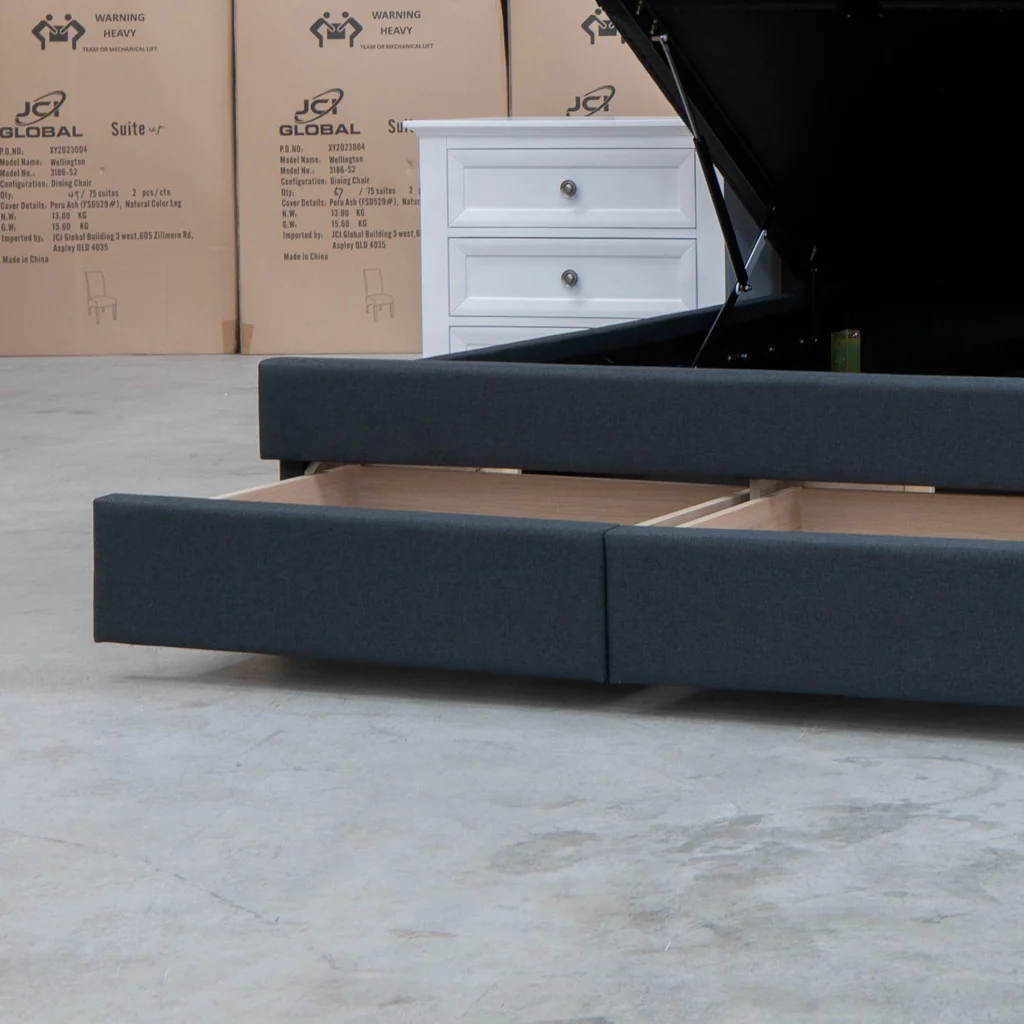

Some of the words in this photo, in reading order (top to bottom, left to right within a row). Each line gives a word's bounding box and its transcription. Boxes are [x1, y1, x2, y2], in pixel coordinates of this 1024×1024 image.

[94, 13, 145, 23] WARNING
[371, 11, 421, 20] WARNING
[103, 28, 137, 38] HEAVY
[380, 25, 413, 34] HEAVY
[294, 94, 340, 118] JCI
[566, 91, 611, 115] JCI
[15, 96, 62, 121] JCI
[0, 125, 83, 139] GLOBAL
[111, 121, 146, 136] Suite
[279, 123, 361, 137] GLOBAL
[49, 146, 87, 154] XY2023004
[51, 158, 86, 167] Wellington
[329, 155, 364, 164] Wellington
[51, 179, 73, 188] Dining
[74, 179, 92, 187] Chair
[330, 176, 351, 186] Dining
[353, 176, 370, 184] Chair
[3, 256, 20, 264] Made
[30, 256, 48, 264] China
[284, 252, 301, 260] Made
[310, 253, 328, 261] China
